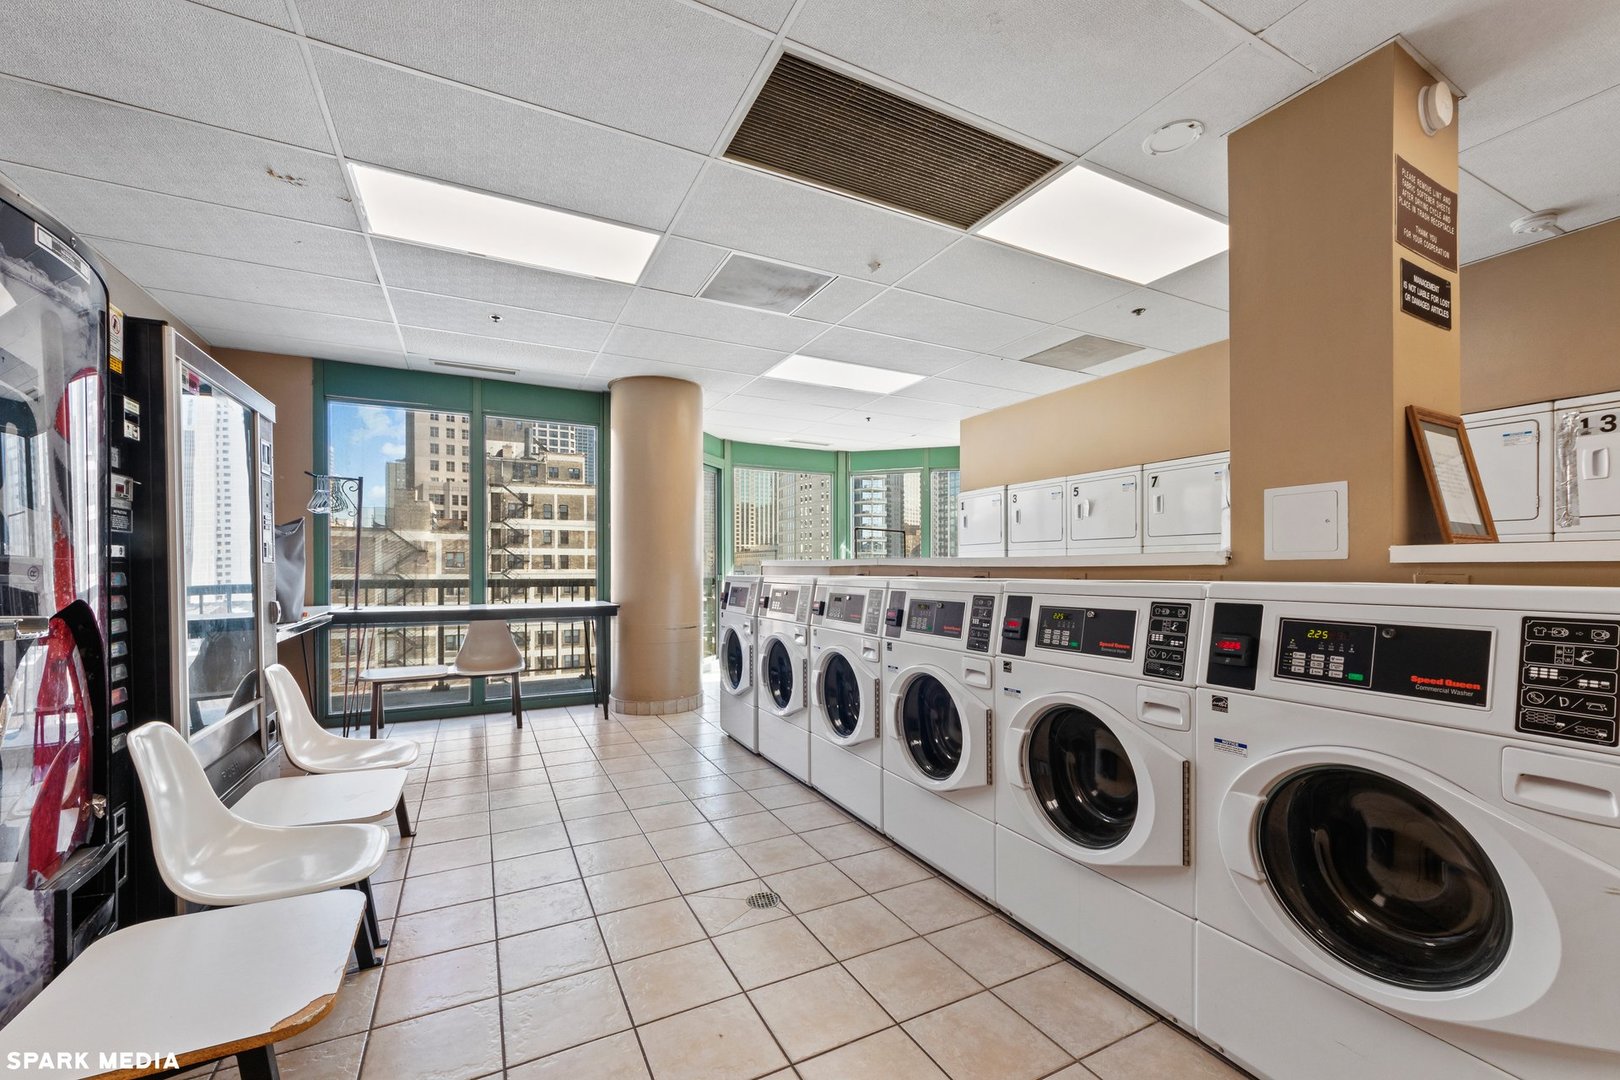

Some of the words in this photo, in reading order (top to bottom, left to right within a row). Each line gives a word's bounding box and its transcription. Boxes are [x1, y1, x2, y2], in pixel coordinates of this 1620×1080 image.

[1401, 167, 1416, 184] PLEASE
[1416, 178, 1432, 195] REMOVE
[1432, 188, 1442, 201] LINT
[1442, 195, 1452, 206] AND
[1402, 178, 1416, 194] FABRIC
[1416, 188, 1435, 206] SOFTENER
[1436, 200, 1451, 215] SHEETS
[1398, 195, 1411, 211] PLACE
[1411, 204, 1417, 214] IN
[1416, 207, 1430, 222] TRASH
[1430, 216, 1455, 235] RECEPTACLE
[1402, 188, 1415, 203] AFTER
[1414, 196, 1429, 212] DRYING
[1429, 206, 1442, 220] CYCLE
[1442, 213, 1452, 224] AND
[1403, 227, 1412, 239] FOR
[1412, 233, 1423, 245] YOUR
[1423, 240, 1450, 259] COOPERATION
[1415, 225, 1429, 239] THANK
[1429, 233, 1438, 244] YOU
[1403, 280, 1408, 290] IS
[1408, 283, 1417, 294] NOT
[1416, 287, 1430, 301] LIABLE
[1430, 293, 1440, 304] FOR
[1439, 297, 1450, 309] LOST
[1413, 274, 1440, 294] MANAGEMENT
[1404, 292, 1411, 302] OR
[1411, 295, 1430, 311] DAMAGED
[1430, 304, 1450, 319] ARTICLES
[1073, 486, 1079, 497] 5
[1151, 475, 1159, 488] 7
[1012, 494, 1018, 503] 3
[1410, 675, 1444, 685] Speed
[1445, 679, 1481, 690] Queen
[1415, 684, 1450, 694] Commercial
[1450, 688, 1474, 697] Washer
